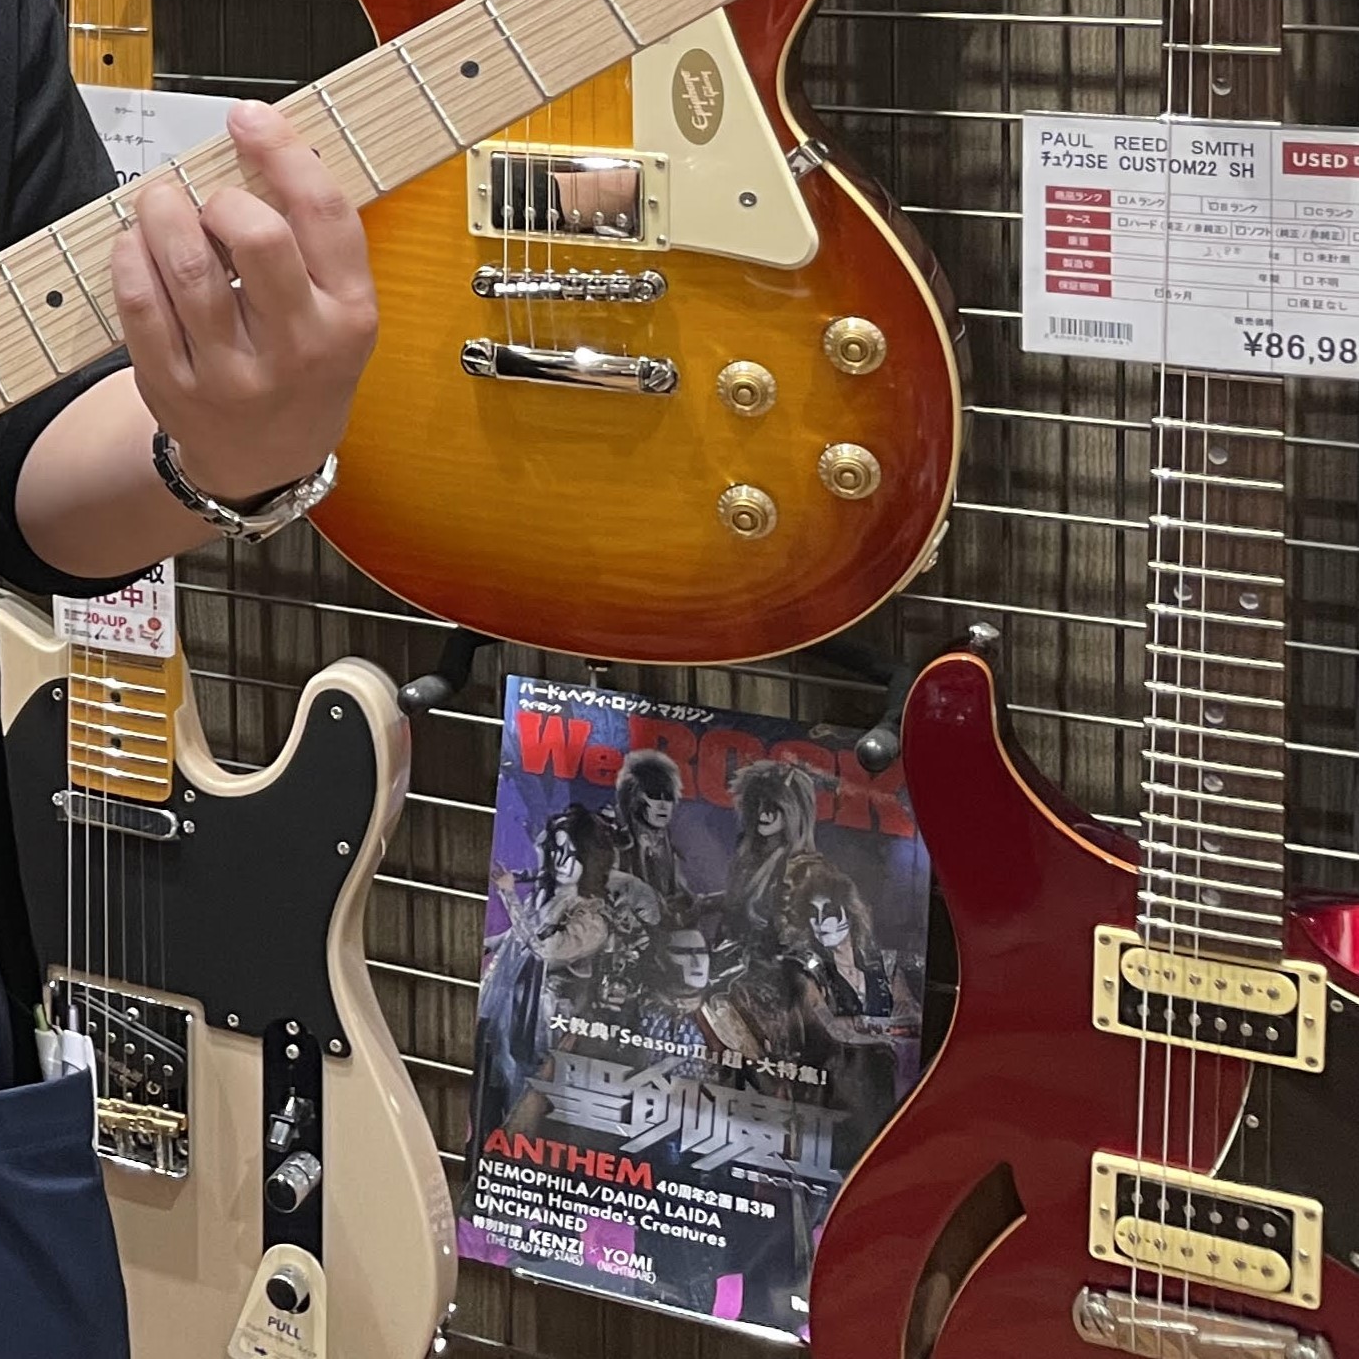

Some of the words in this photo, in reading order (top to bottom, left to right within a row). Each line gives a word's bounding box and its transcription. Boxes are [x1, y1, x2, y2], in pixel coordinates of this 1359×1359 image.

[99, 132, 155, 146] レキギター
[1041, 131, 1094, 149] PAUL
[1114, 135, 1169, 153] REED
[1191, 139, 1255, 158] SMITH
[1118, 155, 1218, 177] CUSTOM22
[1229, 161, 1255, 179] SH
[1292, 151, 1349, 169] USED
[1065, 213, 1091, 224] ケース
[1242, 330, 1359, 366] ¥86,98
[484, 1128, 654, 1190] ANTHEM
[478, 1158, 660, 1215] NEMOPHILA/DAIDA
[666, 1202, 722, 1229] LAIDA
[474, 1194, 588, 1233] UNCHAINED
[476, 1176, 543, 1205] Damian
[548, 1194, 636, 1227] Hamada's
[640, 1216, 727, 1248] Creatures
[507, 1238, 533, 1255] DEAD
[529, 1228, 584, 1255] KENZI
[602, 1246, 653, 1272] YOMI
[267, 1316, 302, 1341] PULL
